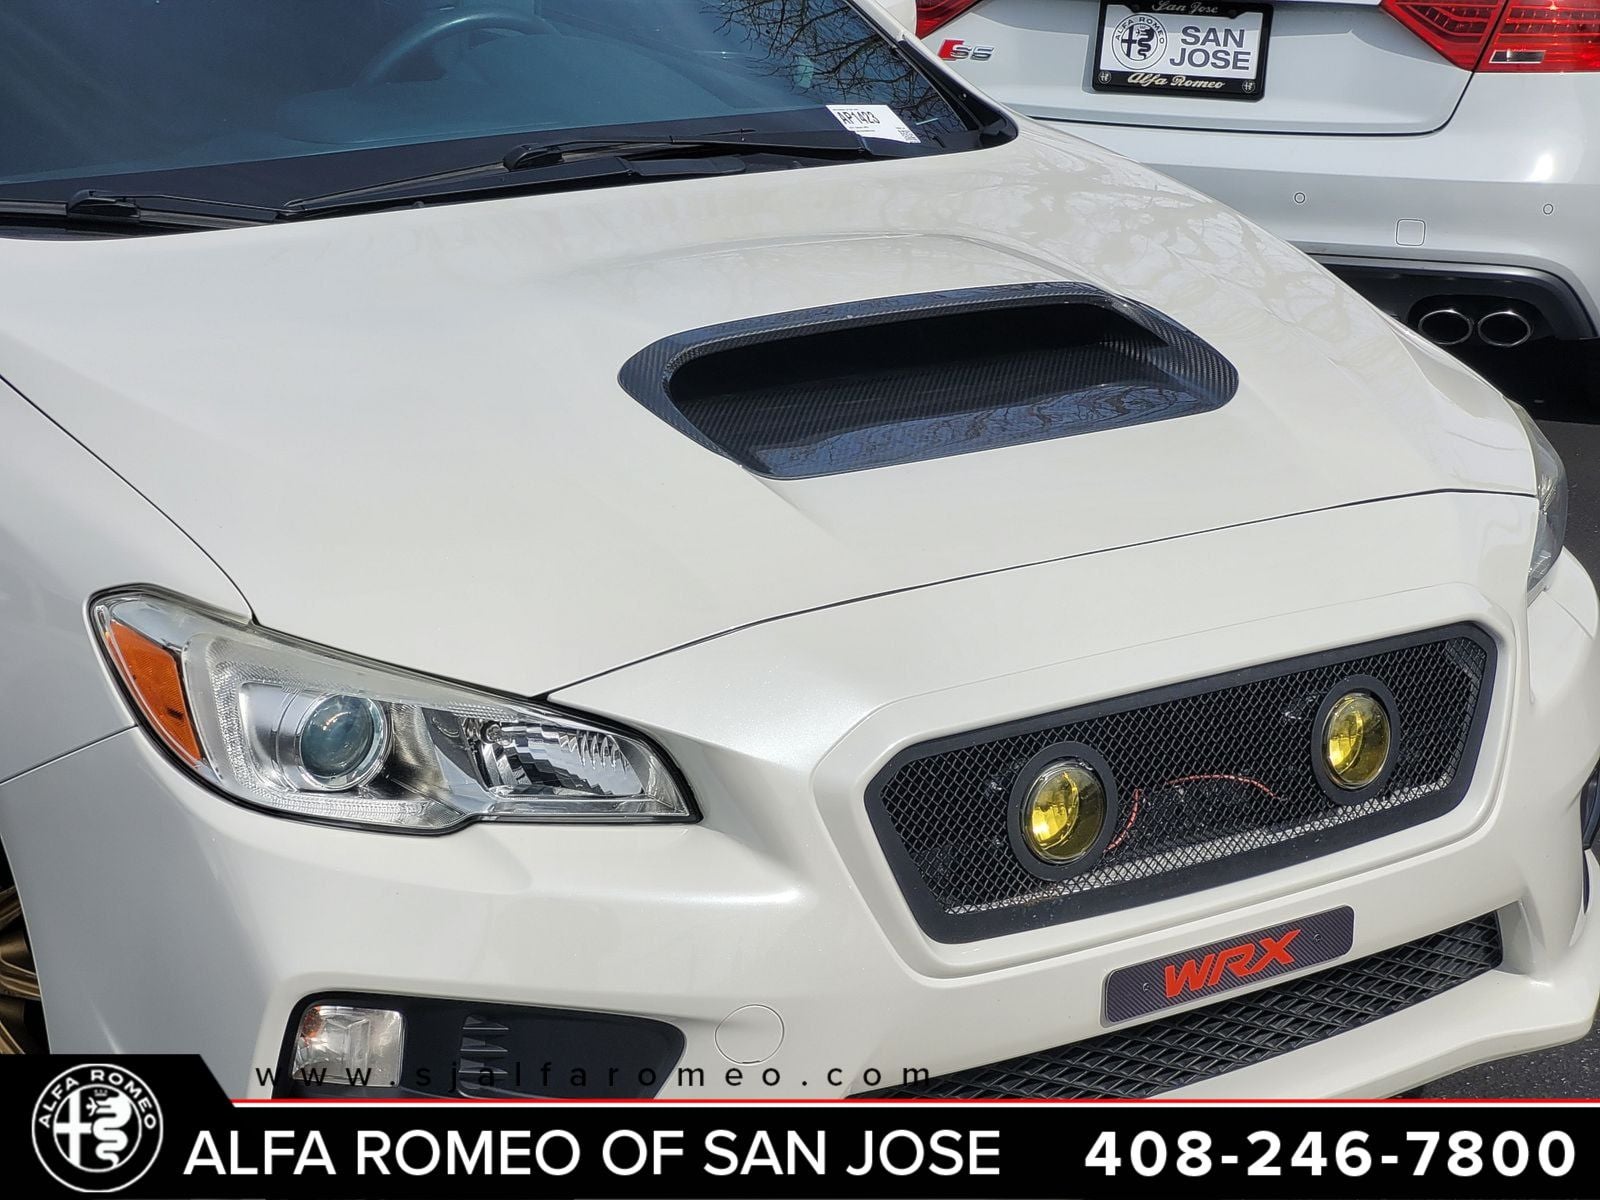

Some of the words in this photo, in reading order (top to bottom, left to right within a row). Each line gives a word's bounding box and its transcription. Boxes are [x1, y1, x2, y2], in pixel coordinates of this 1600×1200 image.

[1115, 19, 1134, 41] ALFA
[1139, 17, 1165, 44] ROMEO
[1180, 26, 1245, 48] SAN
[1169, 48, 1251, 71] JOSE
[1127, 72, 1168, 87] Alfa
[1171, 75, 1226, 89] Romeo
[836, 111, 881, 125] AP1423
[1164, 928, 1301, 998] WRX
